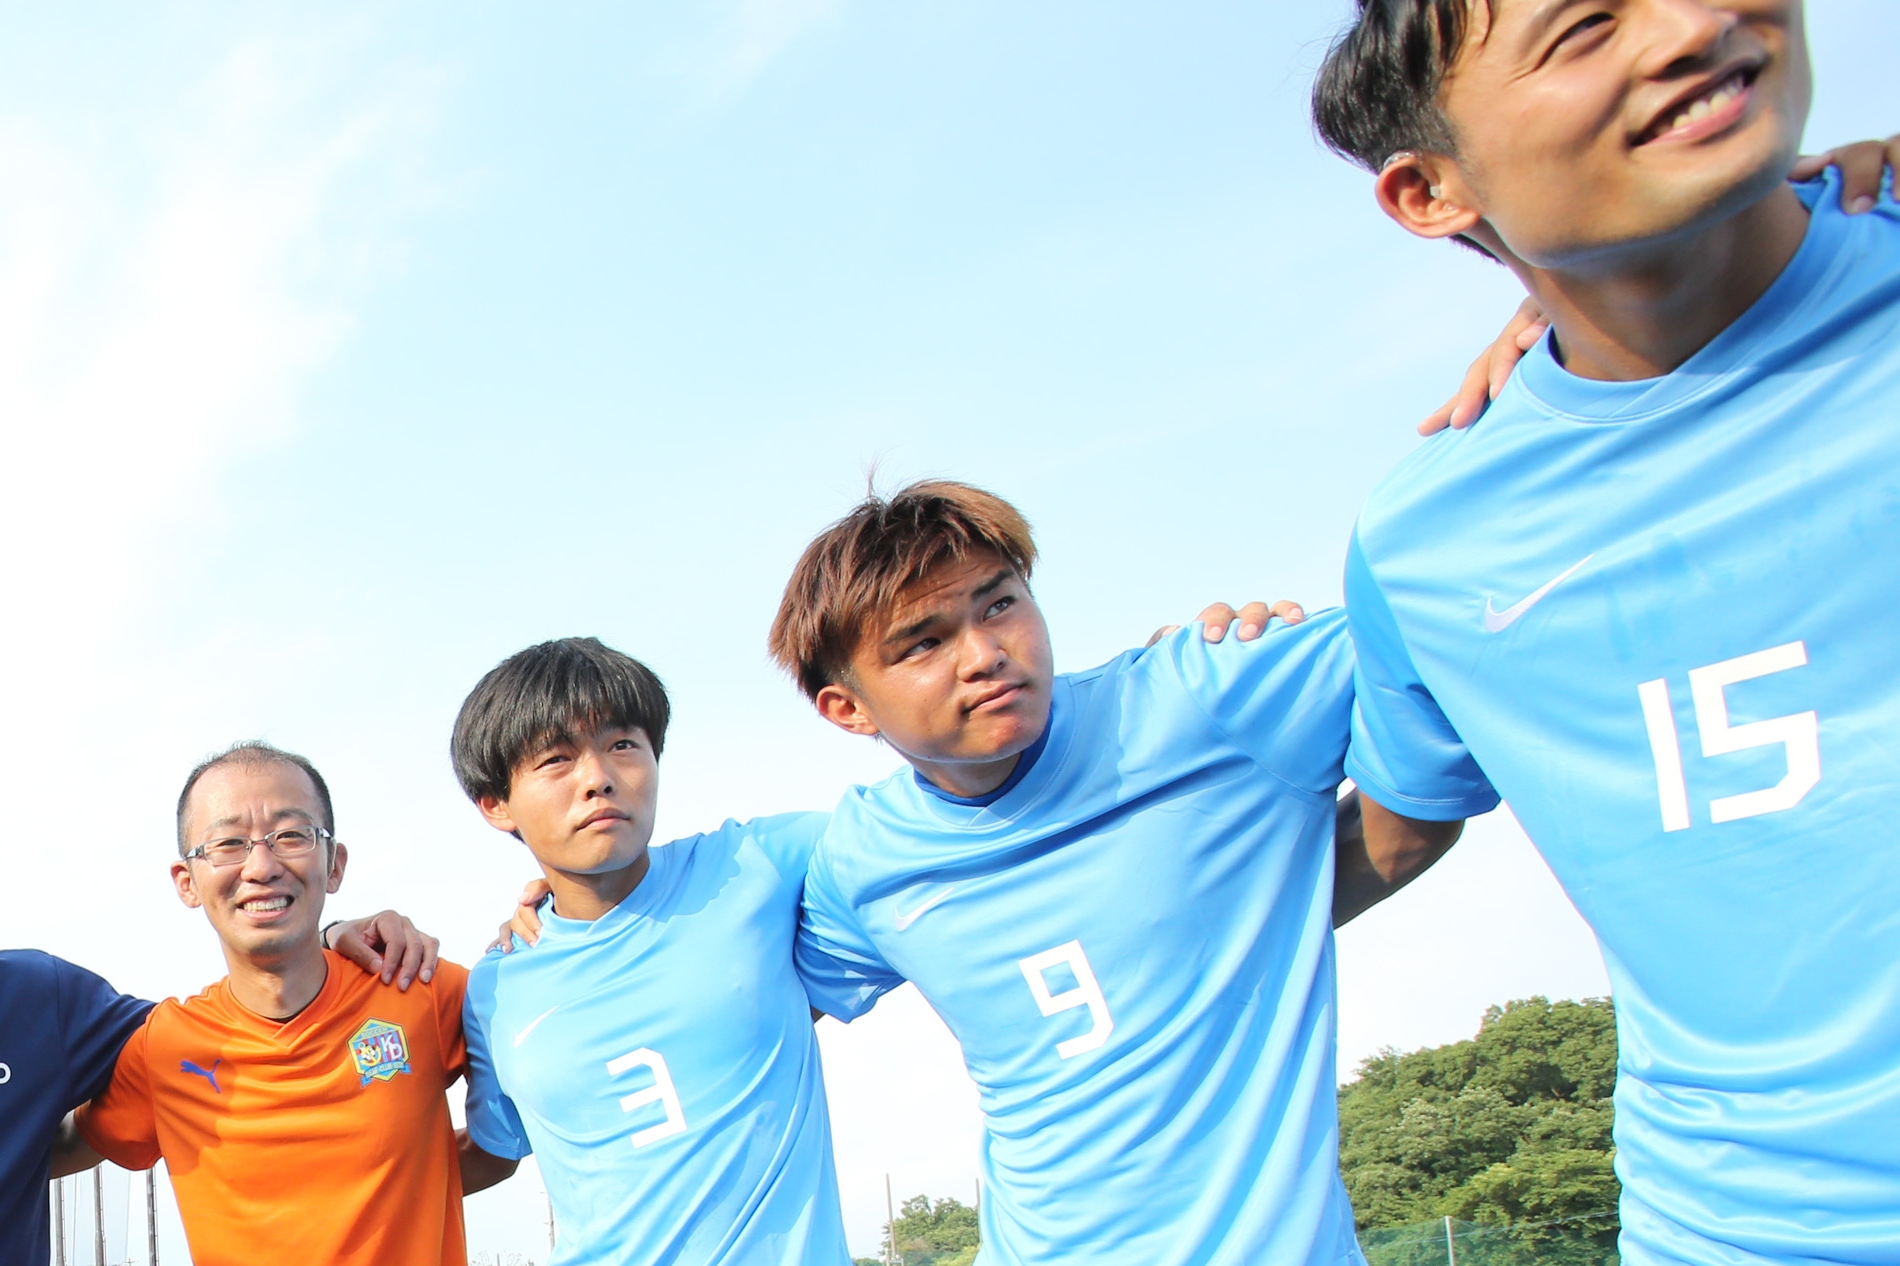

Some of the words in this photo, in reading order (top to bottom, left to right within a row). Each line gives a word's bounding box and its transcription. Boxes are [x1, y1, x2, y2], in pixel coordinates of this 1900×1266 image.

[1637, 640, 1821, 833] 15
[1018, 939, 1114, 1060] 9
[606, 1047, 688, 1148] 3
